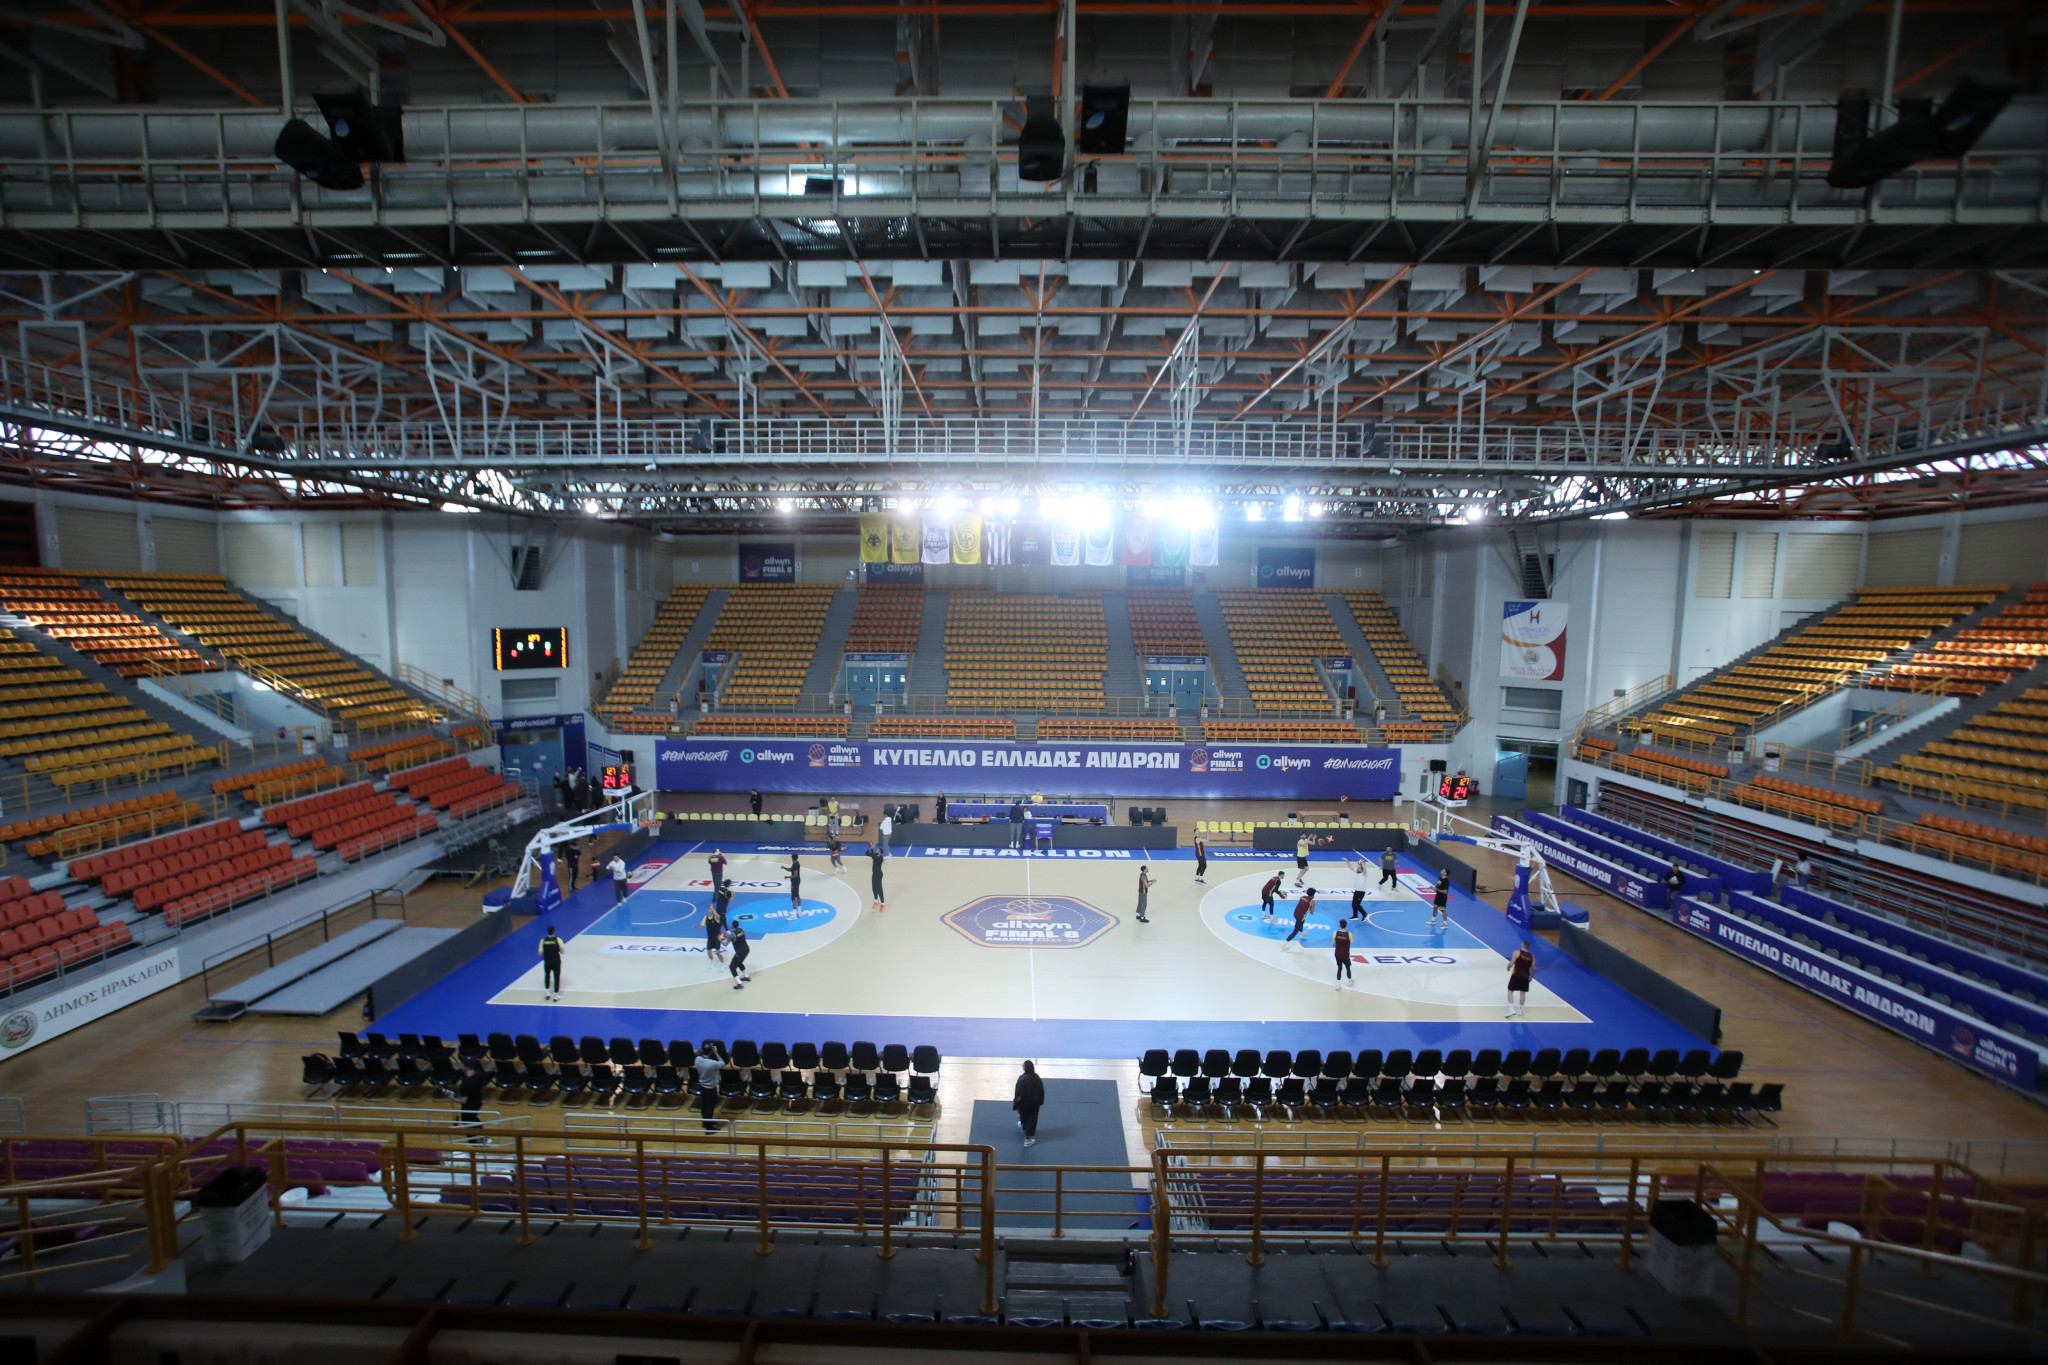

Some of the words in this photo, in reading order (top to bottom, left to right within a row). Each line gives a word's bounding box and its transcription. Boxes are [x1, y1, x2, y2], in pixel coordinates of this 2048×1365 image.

[1276, 566, 1311, 579] allwyn
[830, 744, 859, 755] allwyn
[1213, 750, 1242, 760] allwyn
[757, 750, 794, 764] allwyn
[873, 748, 976, 766] ΚΥΠΕΛΛΟ
[981, 750, 1081, 768] ΕΛΛΑΔΑΣ
[1085, 751, 1180, 769] ΑΝΔΡΩΝ
[1273, 755, 1311, 770] allwyn
[603, 775, 617, 788] 24
[1439, 783, 1451, 797] 24
[1453, 786, 1468, 799] 24
[924, 847, 1131, 858] HERAKLION
[992, 920, 1072, 931] allwyn
[985, 930, 1060, 938] FINAL
[1063, 930, 1080, 938] 8
[1373, 955, 1457, 965] EKO
[1718, 923, 1780, 963] ΚΥΠΕΛΛΟ
[1782, 954, 1853, 995] ΕΛΛΑΔΑΣ
[1854, 985, 1935, 1036] ΑΝΔΡΩΝ
[43, 989, 99, 1023] ΔΗΜΟΣ
[101, 956, 177, 999] ΗΡΑΚΛΕΙΟΥ
[1979, 1038, 2017, 1062] allwyn
